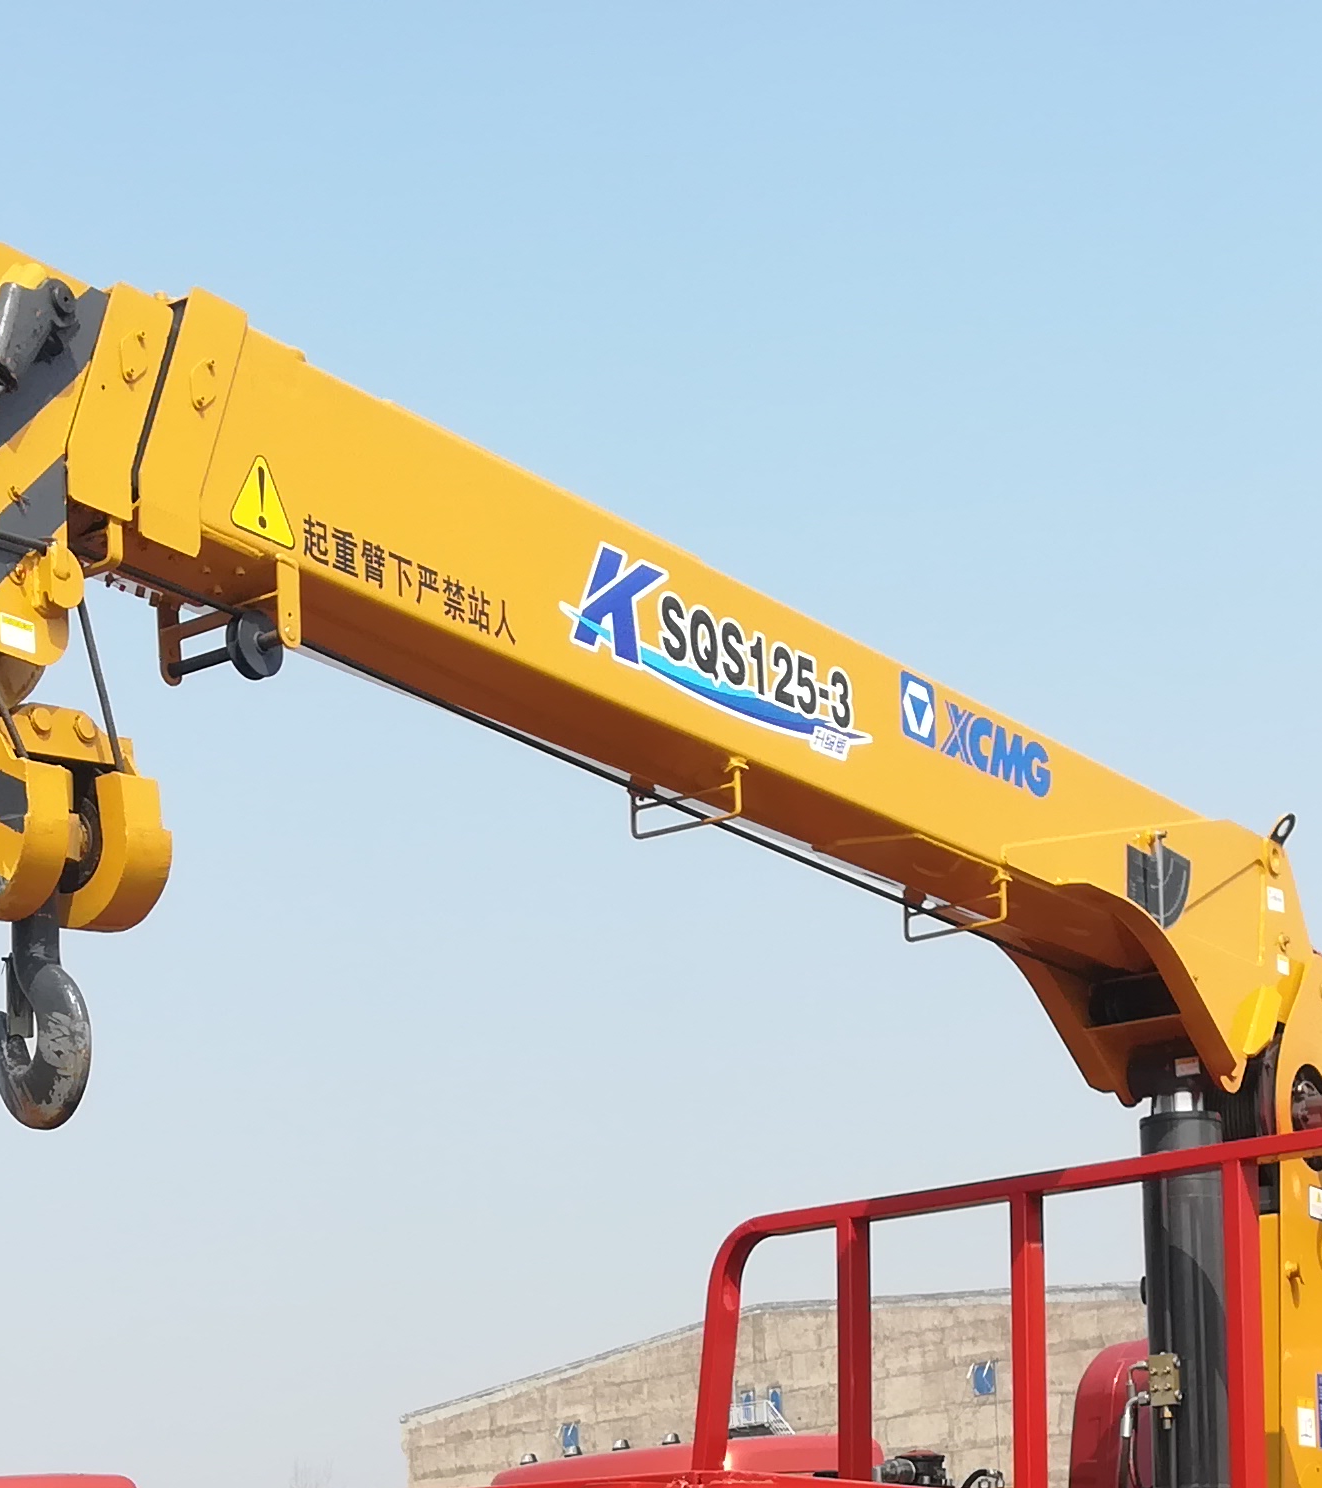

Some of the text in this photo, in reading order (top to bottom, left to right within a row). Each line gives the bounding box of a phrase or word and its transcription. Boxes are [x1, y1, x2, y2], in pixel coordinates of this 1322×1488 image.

[303, 513, 516, 645] 起重臂下严禁站人
[661, 595, 851, 729] SQS125-3
[940, 699, 1051, 798] XCMG
